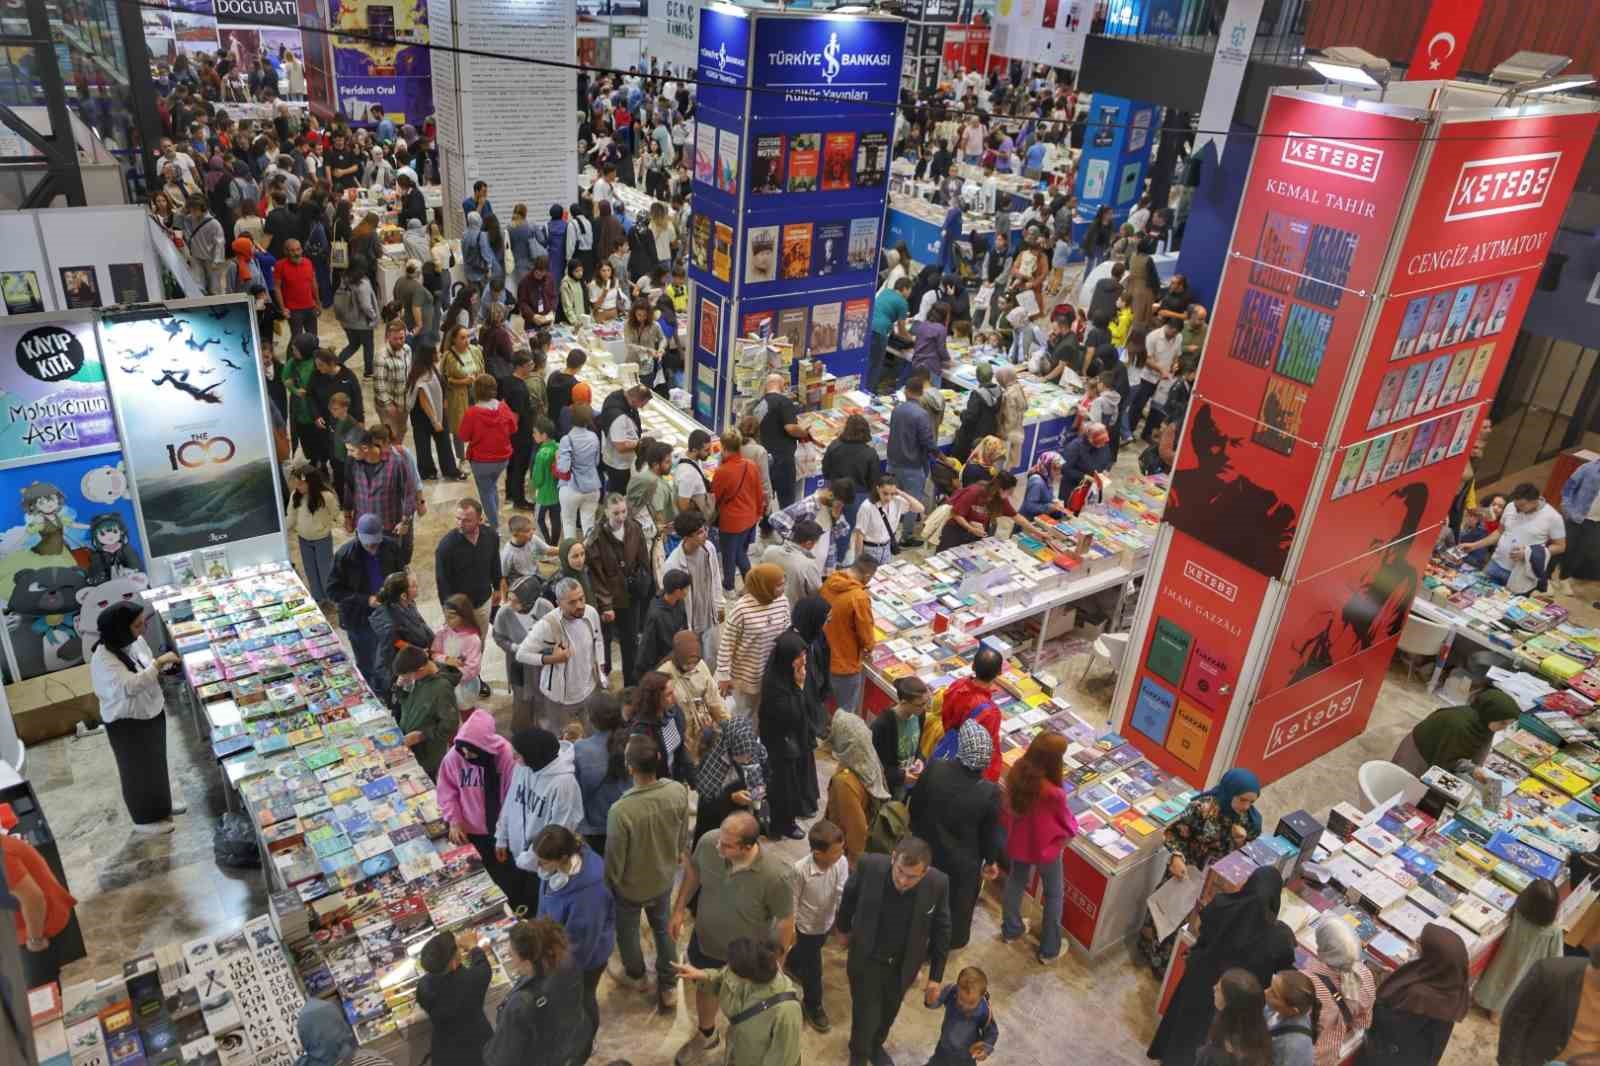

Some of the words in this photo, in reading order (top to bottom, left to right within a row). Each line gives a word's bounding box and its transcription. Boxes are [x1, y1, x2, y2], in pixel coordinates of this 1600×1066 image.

[768, 50, 821, 66] TÜRKİYE
[841, 53, 891, 66] BANKASI
[376, 84, 396, 96] Oral
[1289, 140, 1375, 173] KETEBE
[1265, 177, 1320, 204] KEMAL
[1457, 167, 1550, 206] KETEBE
[1468, 231, 1548, 264] AYTMATOV
[21, 333, 72, 360] KAYIP
[191, 432, 208, 441] THE
[166, 436, 235, 470] 100
